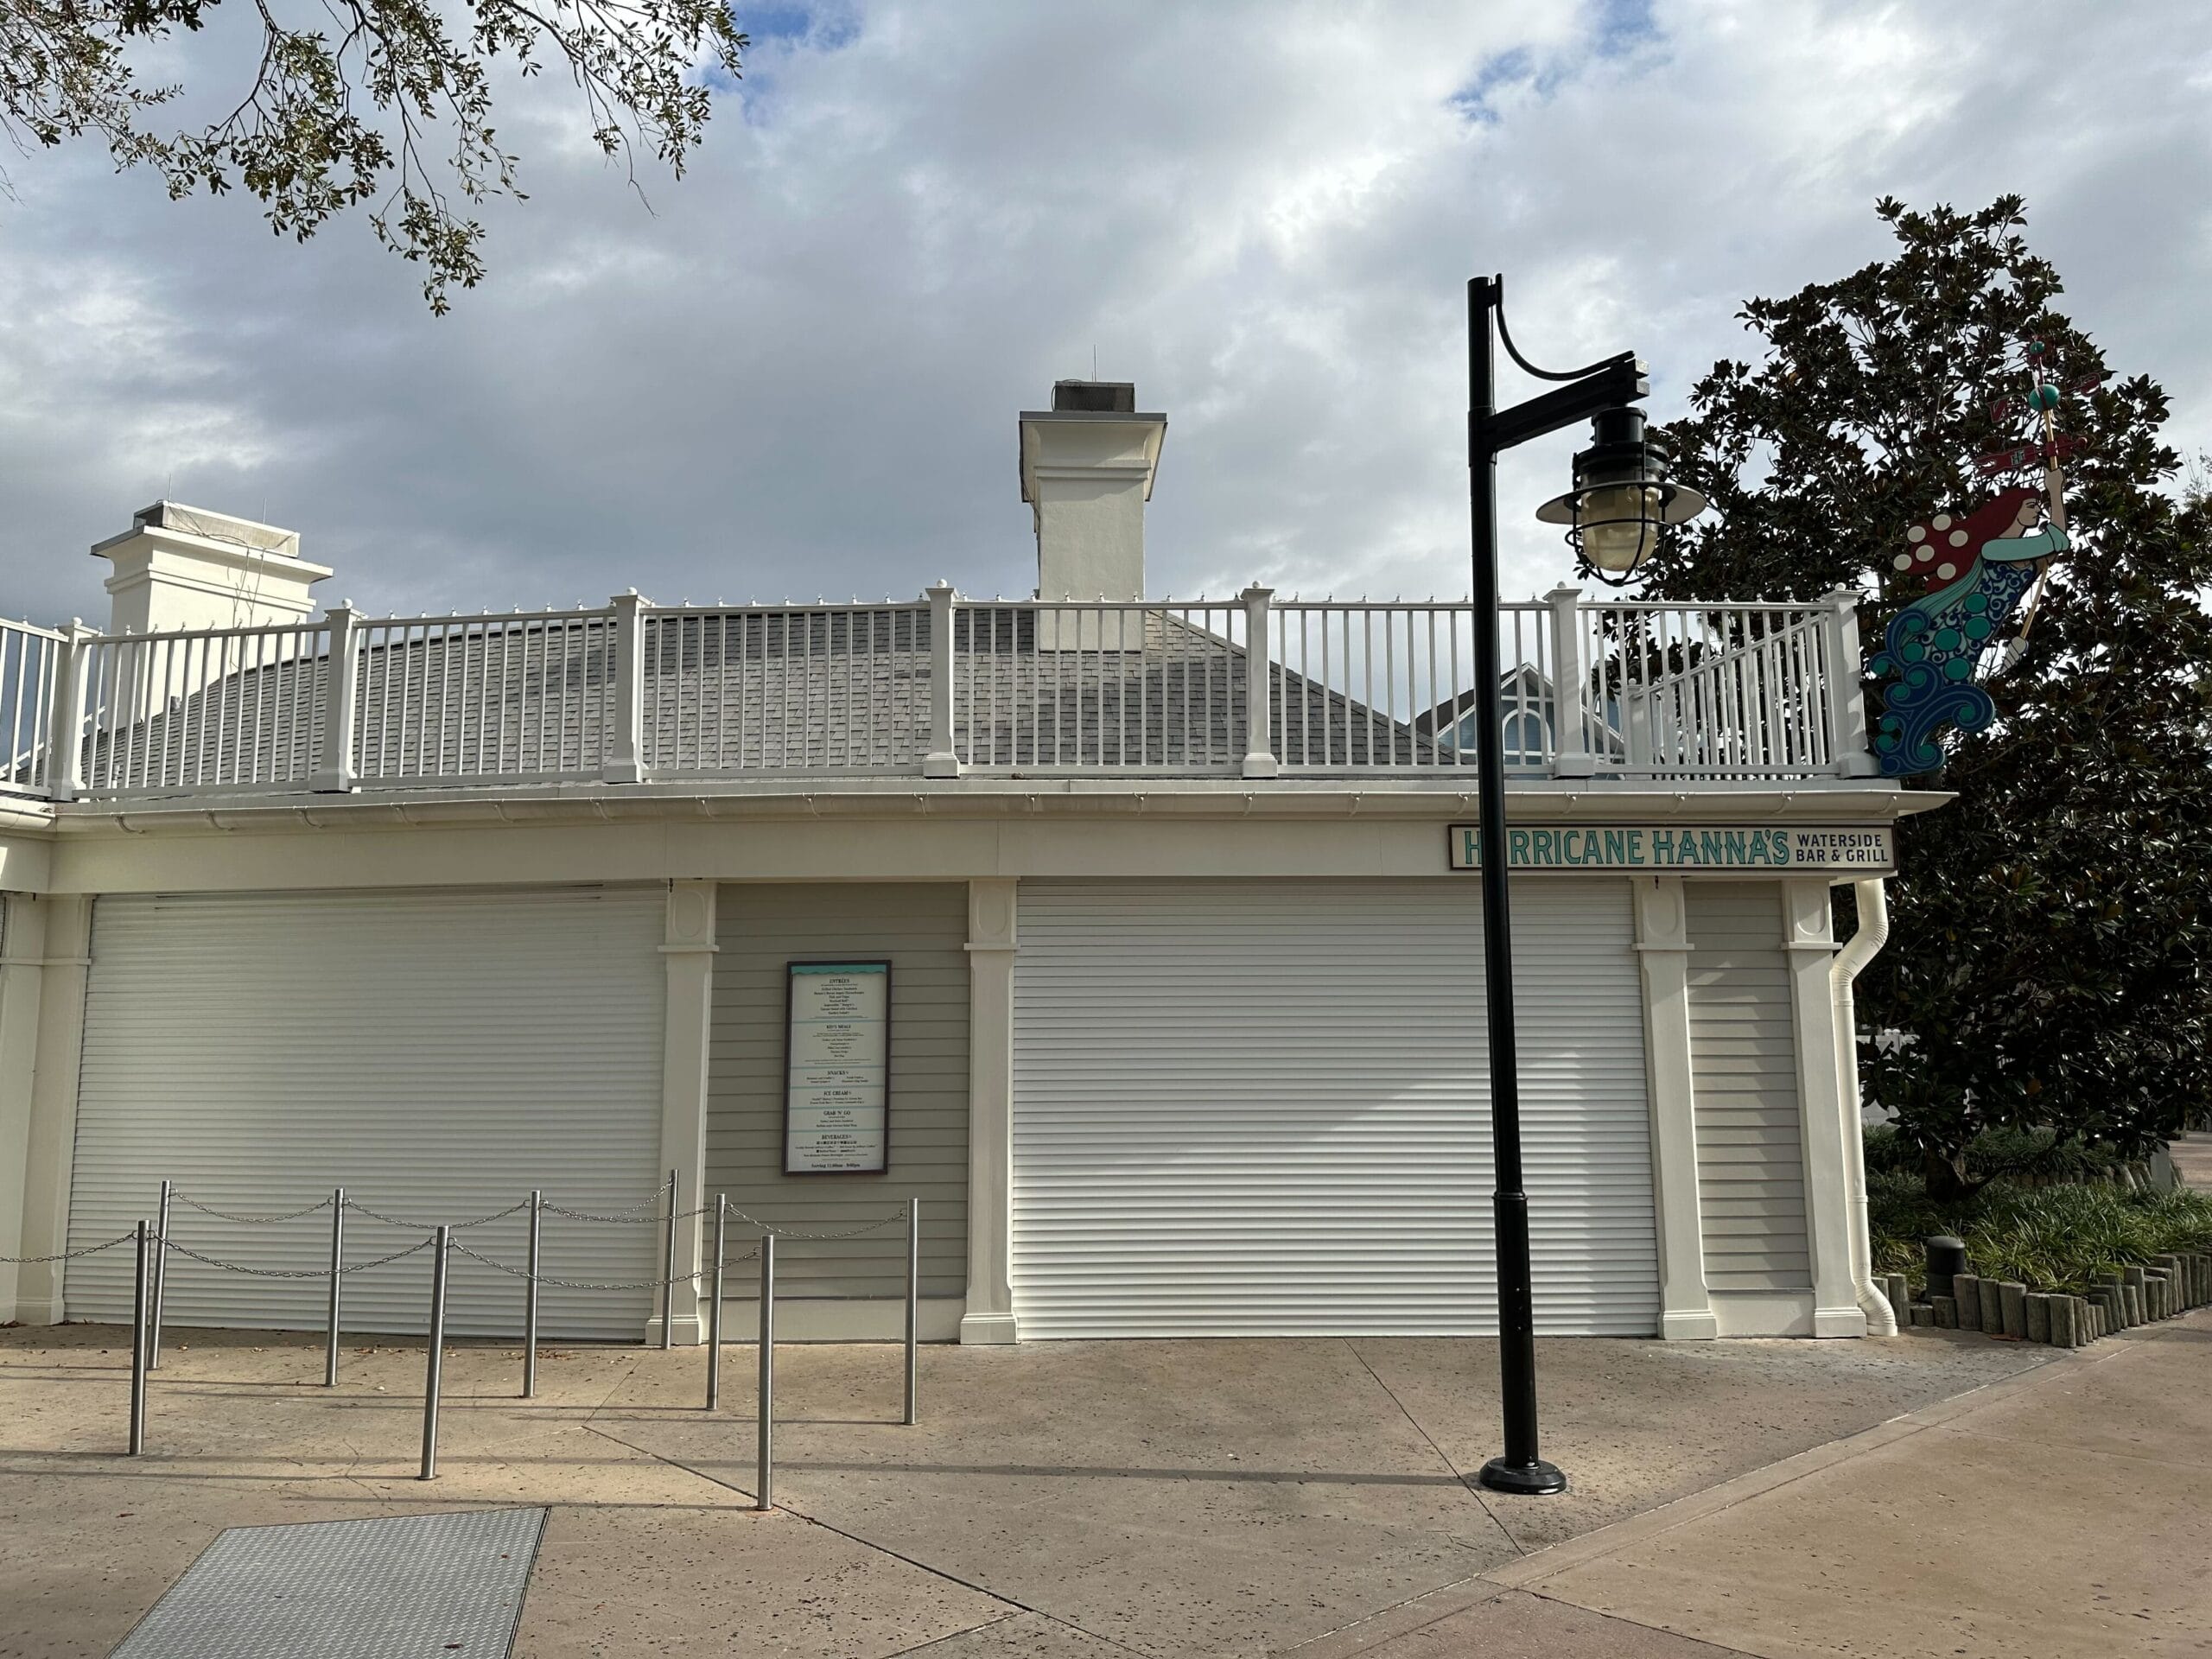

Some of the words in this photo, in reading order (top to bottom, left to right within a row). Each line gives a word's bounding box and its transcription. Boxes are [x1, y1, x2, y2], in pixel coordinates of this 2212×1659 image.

[1465, 830, 1645, 865] HRRICANE
[1652, 829, 1790, 865] HANNA'S
[1797, 834, 1882, 848] WATERSIDE
[1796, 849, 1826, 862] BAR
[1831, 849, 1840, 861] &
[1847, 849, 1888, 861] GRILL
